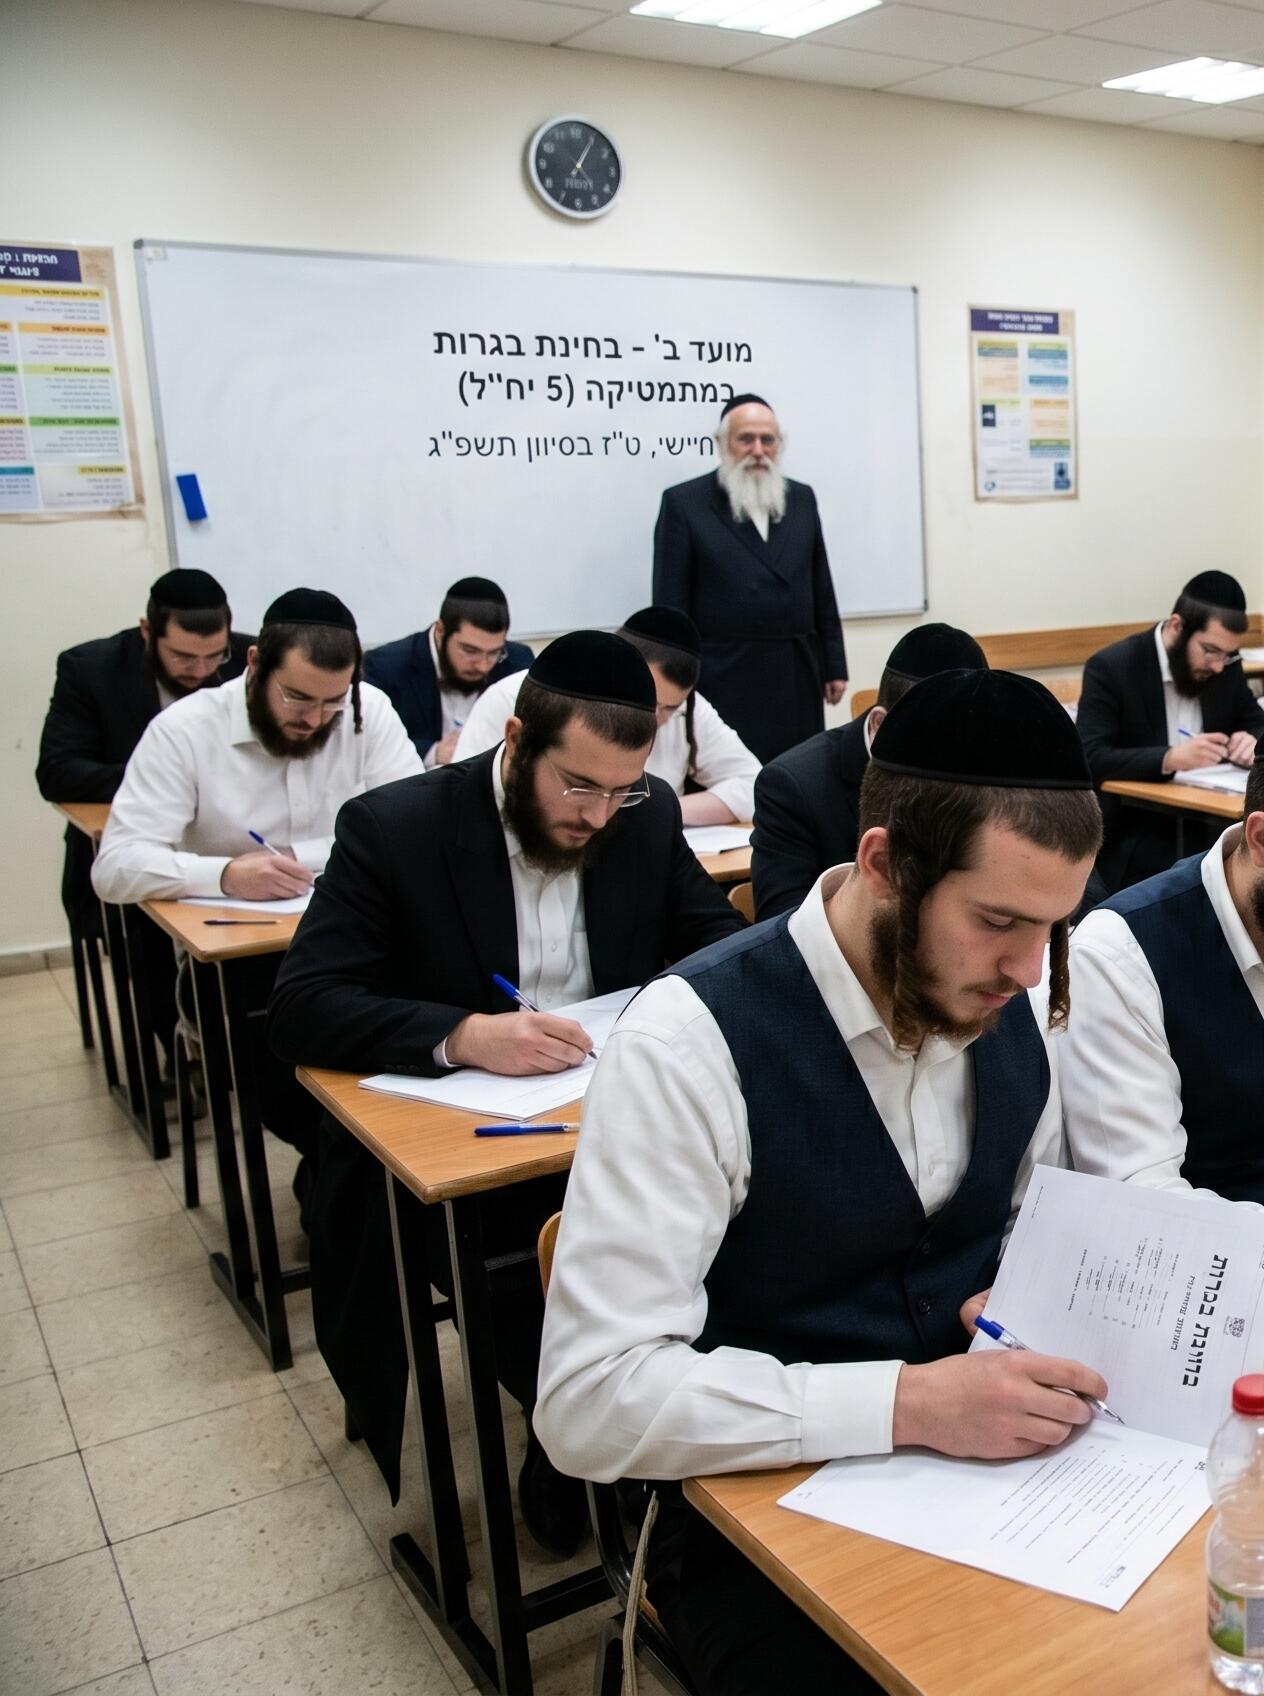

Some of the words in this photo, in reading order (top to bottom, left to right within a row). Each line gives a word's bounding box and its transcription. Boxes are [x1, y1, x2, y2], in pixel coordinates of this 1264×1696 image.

[433, 331, 526, 357] בגרות
[534, 335, 623, 359] בחינת
[654, 333, 681, 361] ב'
[689, 341, 752, 364] מועד
[586, 379, 734, 410] במתמטיקה
[428, 430, 516, 457] תשפ"ג
[527, 436, 594, 463] בסיוון
[601, 431, 641, 456] ט"ז
